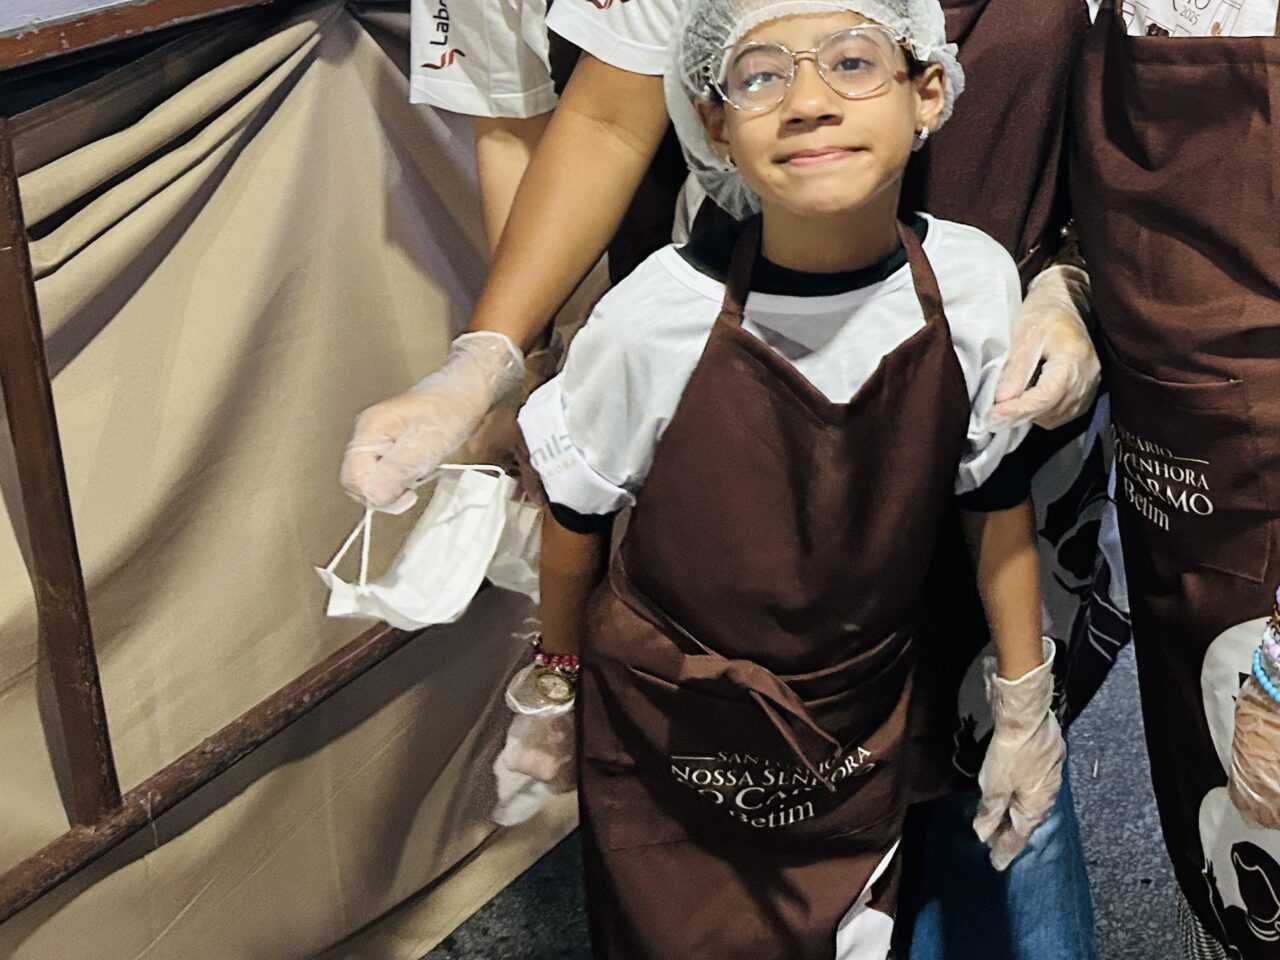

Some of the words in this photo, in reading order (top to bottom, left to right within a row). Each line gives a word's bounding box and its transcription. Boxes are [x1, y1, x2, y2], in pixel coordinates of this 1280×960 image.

[1179, 5, 1200, 25] 2025
[1124, 477, 1170, 531] Betim
[671, 764, 754, 786] NOSSA
